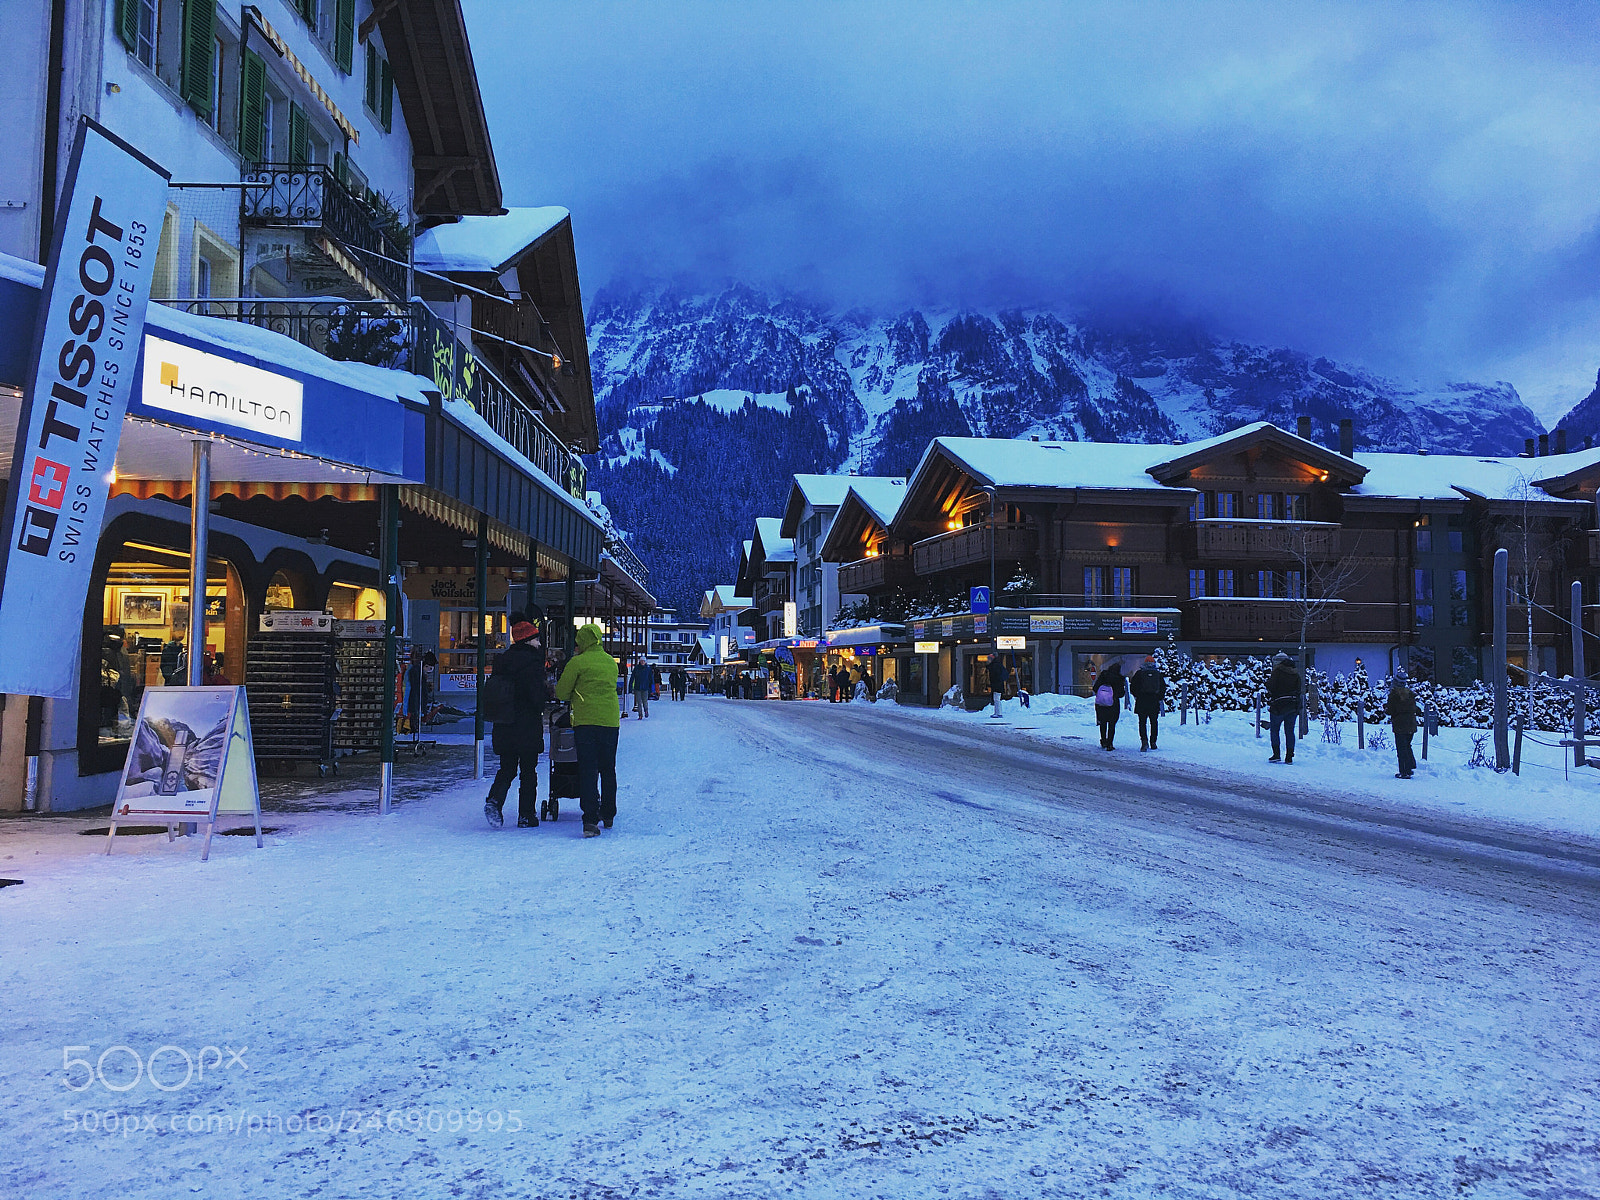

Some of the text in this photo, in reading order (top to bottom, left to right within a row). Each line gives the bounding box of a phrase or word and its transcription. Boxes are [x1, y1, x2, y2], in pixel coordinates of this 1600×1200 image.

[38, 195, 124, 450] TISSOT
[59, 219, 148, 564] SWISS WATCHES SINCE 1853
[170, 380, 291, 425] HAMILTON
[431, 580, 456, 589] Jack
[431, 589, 476, 598] Wolfskin
